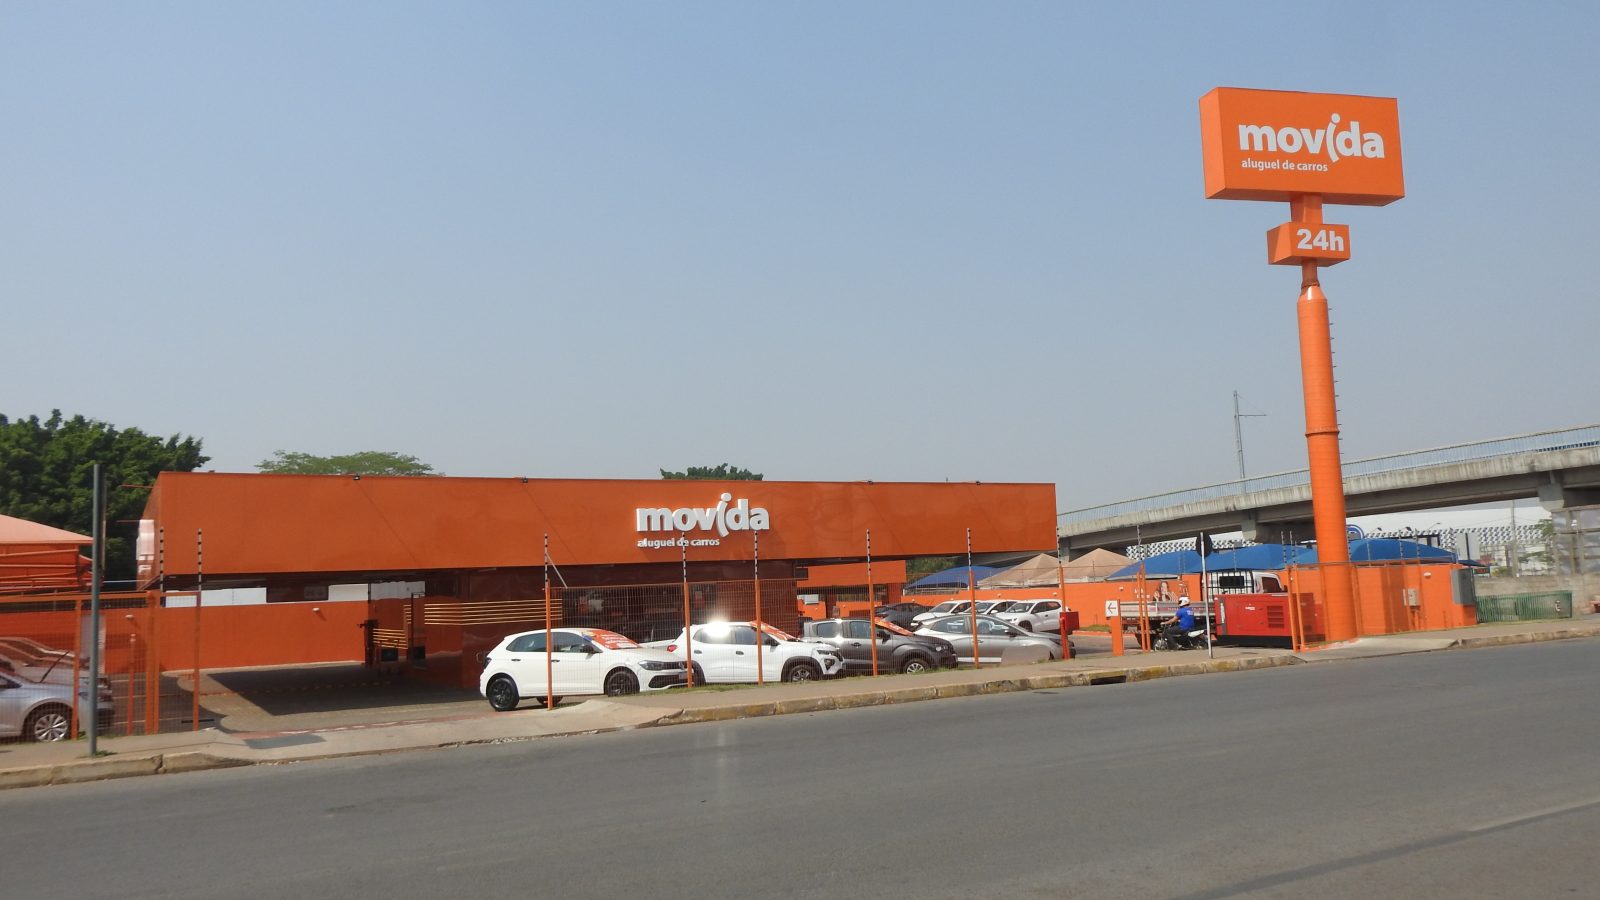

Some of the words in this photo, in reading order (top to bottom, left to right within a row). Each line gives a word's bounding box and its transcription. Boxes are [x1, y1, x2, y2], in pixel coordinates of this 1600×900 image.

[1238, 113, 1385, 163] movida
[1241, 157, 1280, 171] aluguel
[1282, 160, 1295, 170] de
[1296, 162, 1328, 172] carros
[1296, 228, 1345, 252] 24h
[636, 492, 770, 538] movida
[637, 538, 675, 549] aluguel
[676, 537, 689, 547] de
[690, 539, 720, 547] carros
